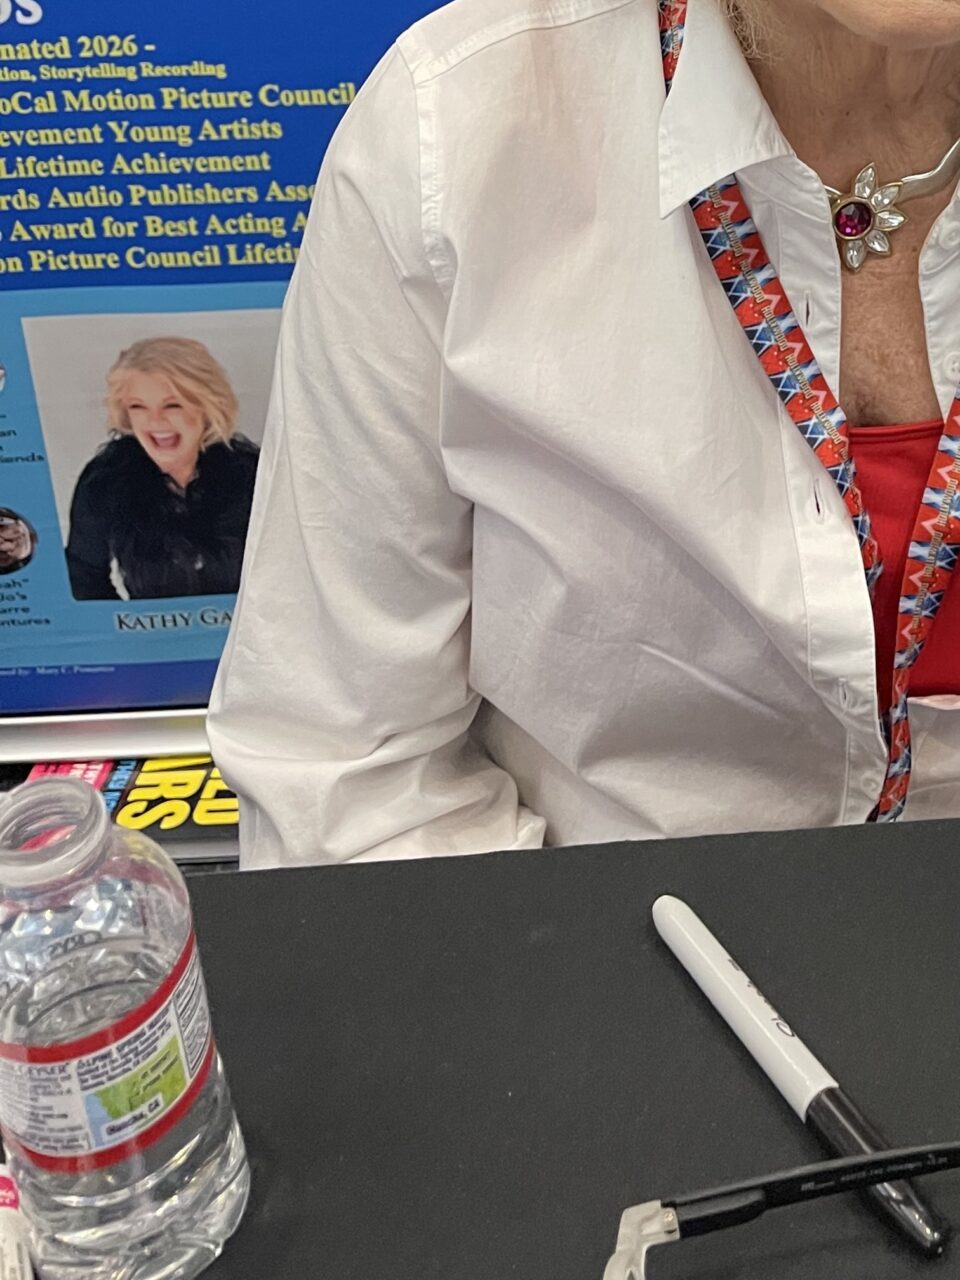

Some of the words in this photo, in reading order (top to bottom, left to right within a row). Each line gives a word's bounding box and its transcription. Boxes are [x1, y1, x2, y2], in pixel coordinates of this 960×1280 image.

[78, 34, 138, 58] 2026
[40, 64, 137, 83] Storytelling
[140, 61, 227, 80] Recording
[63, 89, 155, 113] Motion
[161, 86, 253, 110] Picture
[258, 82, 356, 107] Council
[107, 119, 193, 147] Young
[199, 117, 283, 141] Artists
[0, 155, 104, 179] Lifetime
[111, 150, 271, 176] Achievement
[48, 185, 123, 209] Audio
[129, 182, 258, 207] Publishers
[10, 217, 97, 241] Award
[102, 216, 138, 238] for
[145, 214, 198, 237] Best
[205, 211, 287, 238] Acting
[28, 249, 120, 272] Picture
[125, 244, 222, 269] Council
[116, 612, 192, 631] KATHY
